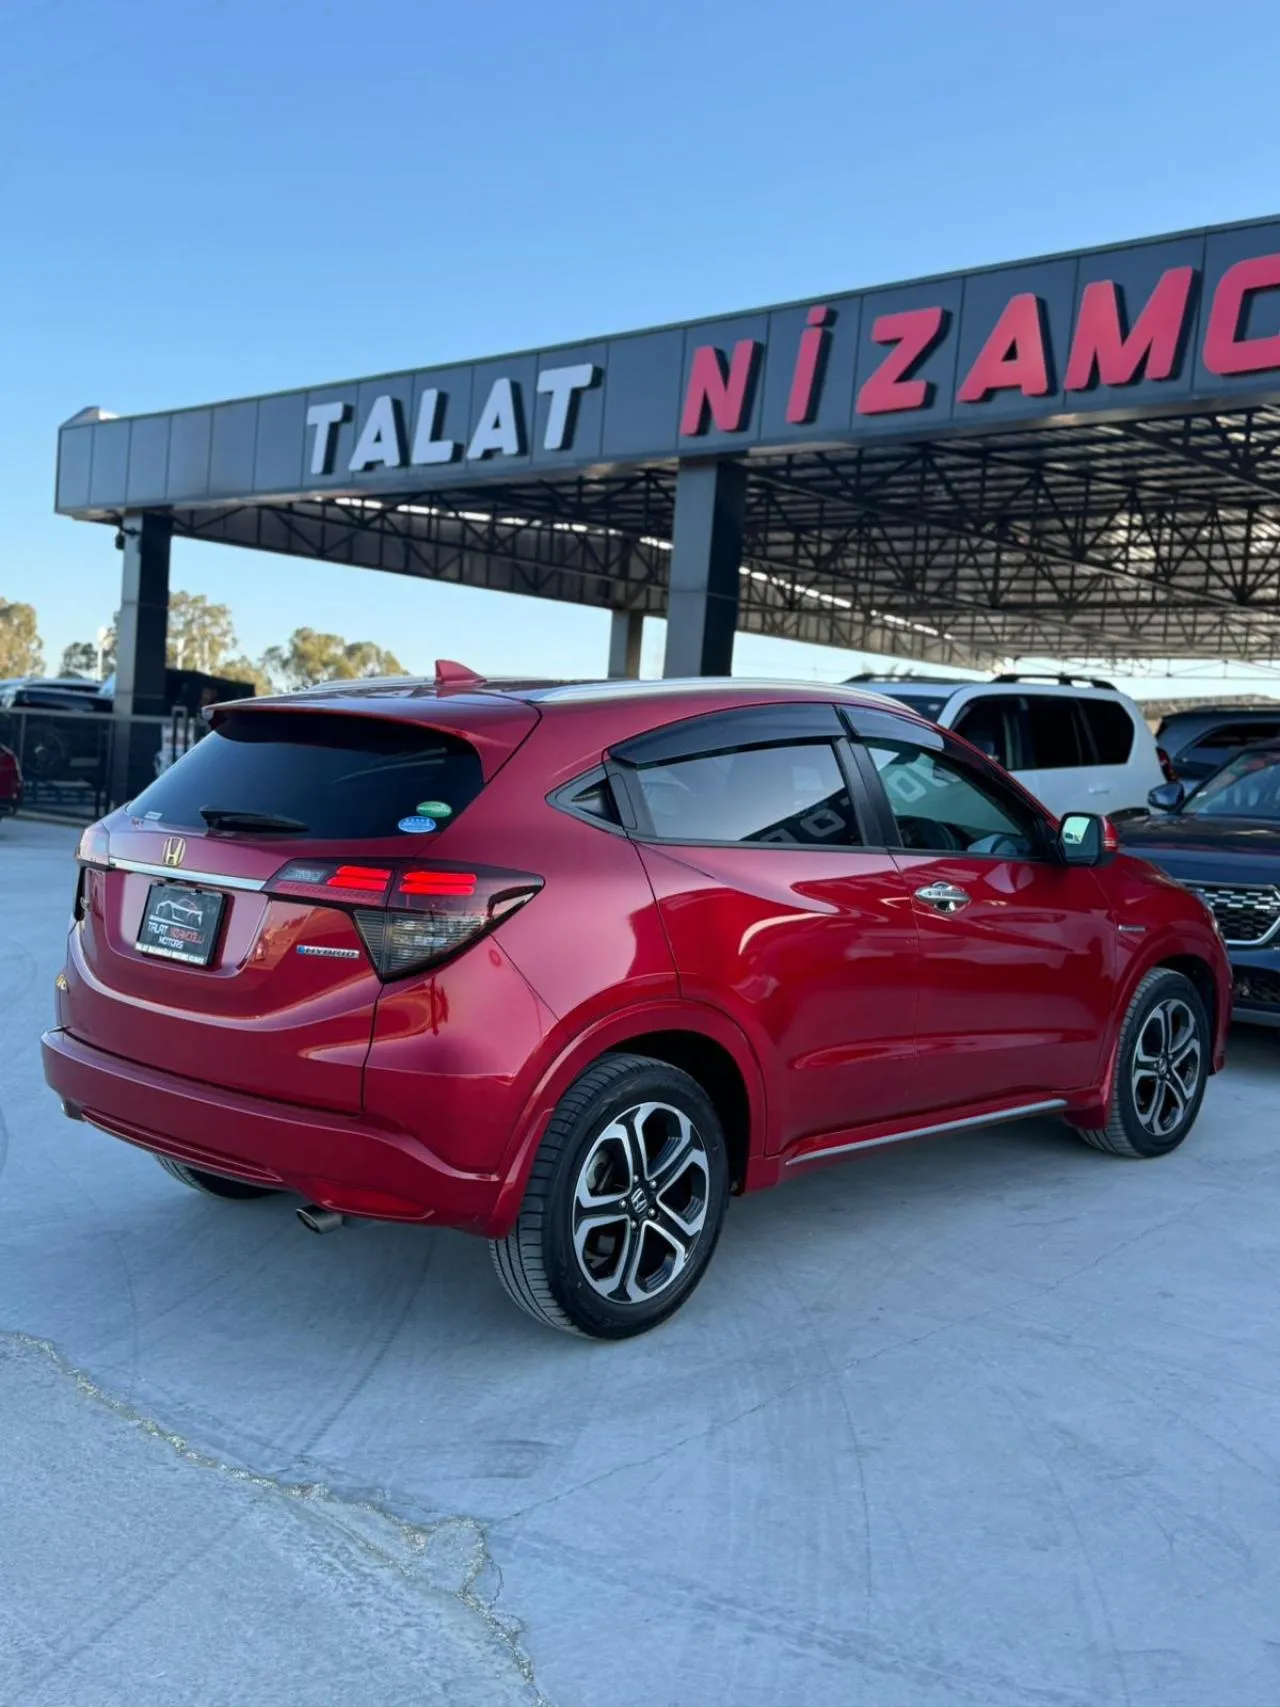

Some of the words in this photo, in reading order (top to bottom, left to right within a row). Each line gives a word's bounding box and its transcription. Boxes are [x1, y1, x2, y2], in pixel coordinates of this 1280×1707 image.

[306, 362, 600, 476] TALAT
[147, 921, 169, 935] TALAT
[158, 936, 184, 950] MOTORS
[304, 947, 357, 958] HYBRID
